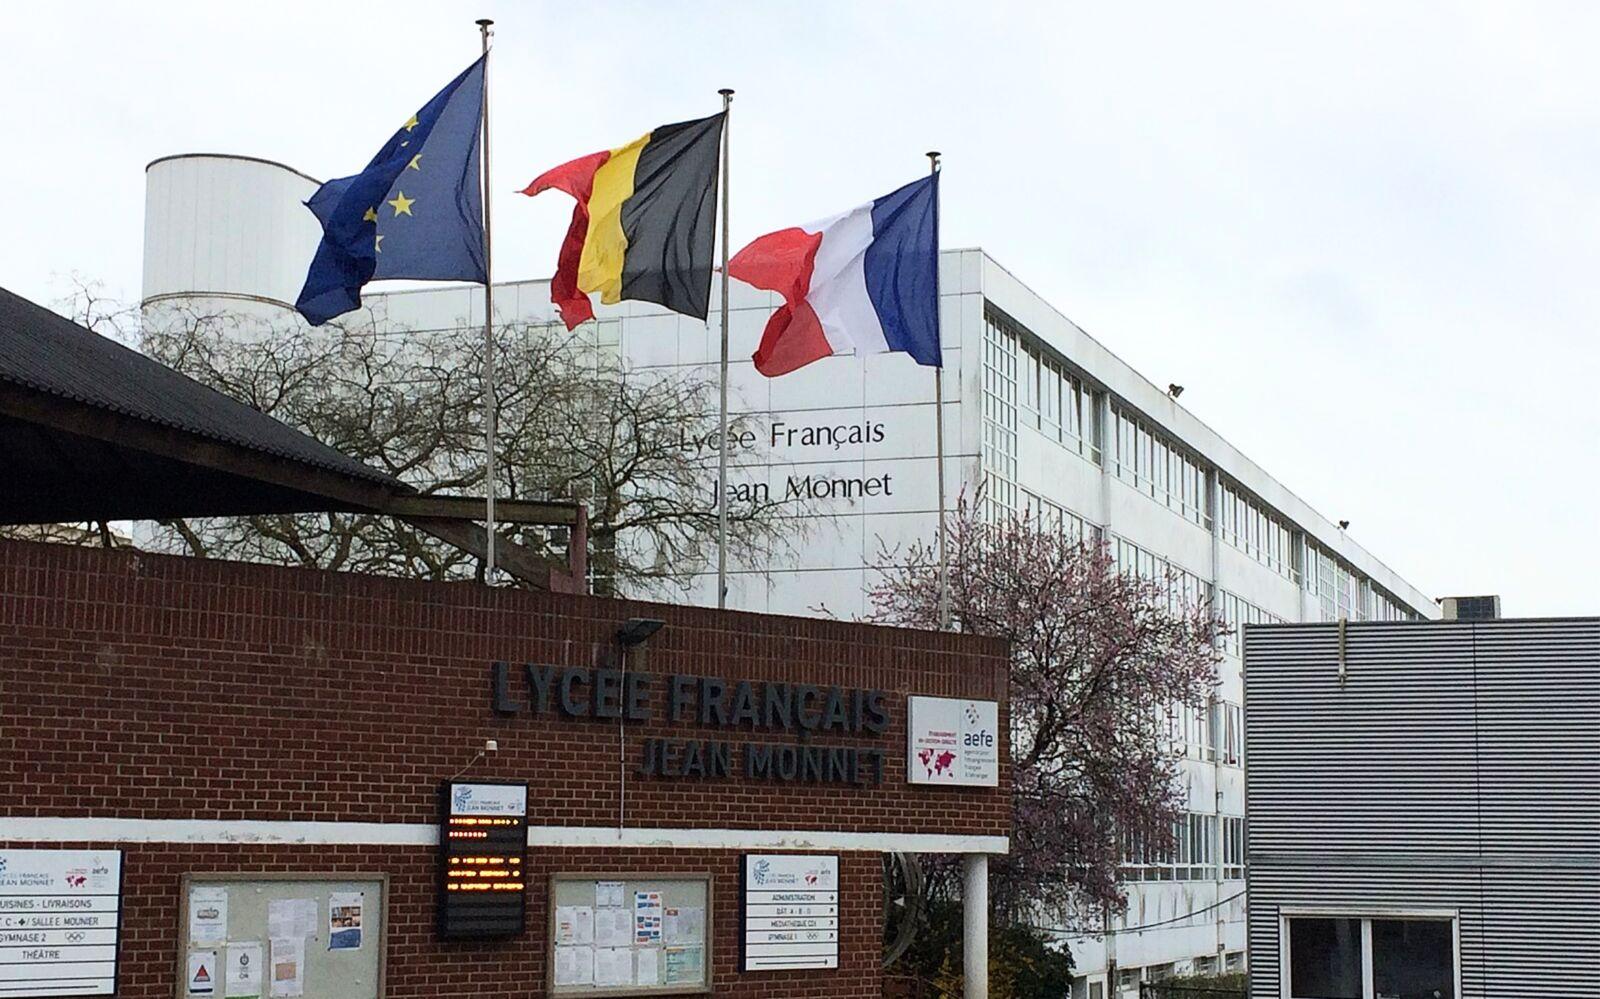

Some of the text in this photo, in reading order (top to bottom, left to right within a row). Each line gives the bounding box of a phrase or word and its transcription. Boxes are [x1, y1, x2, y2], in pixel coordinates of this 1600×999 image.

[771, 421, 885, 450] Français
[709, 473, 892, 510] Jean Monnet
[669, 674, 891, 738] FRANÇAIS
[963, 729, 993, 747] aefe
[638, 738, 885, 786] JEAN MONNET
[0, 900, 34, 909] UISINES
[42, 899, 92, 909] LIVRAISONS
[31, 917, 54, 927] SALLE
[64, 917, 99, 926] MOUNIER
[41, 934, 47, 942] 2
